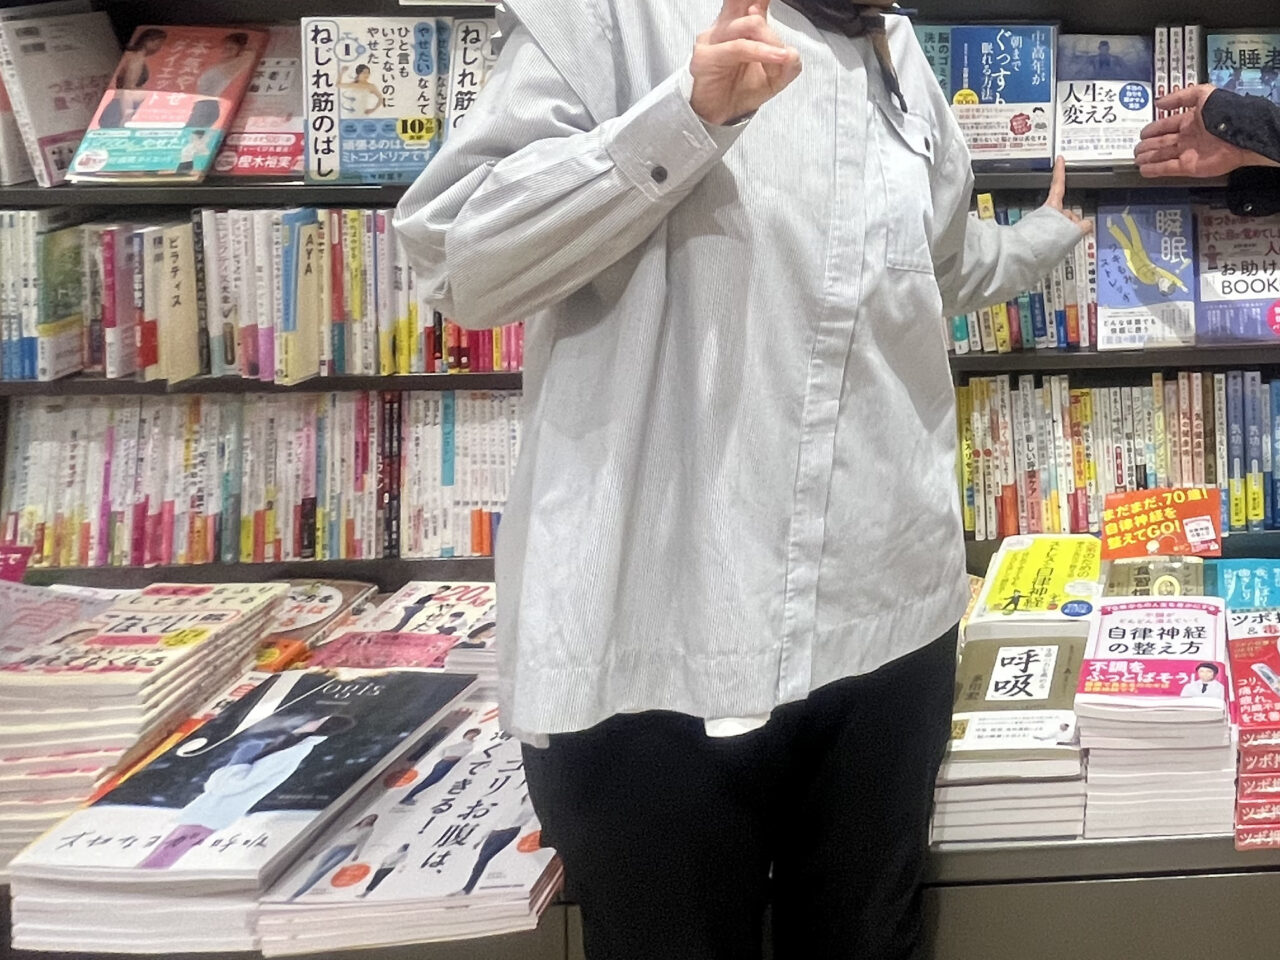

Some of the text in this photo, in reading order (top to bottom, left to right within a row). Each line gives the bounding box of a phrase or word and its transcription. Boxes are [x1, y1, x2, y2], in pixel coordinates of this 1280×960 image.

[367, 27, 380, 65] やせた
[397, 27, 410, 78] ひと言も
[382, 27, 395, 108] いってないのに
[417, 27, 430, 115] やせたい なんて
[311, 25, 335, 178] ねじれ筋のばし
[1064, 83, 1117, 103] 人生を
[1063, 105, 1117, 125] 変える
[1156, 209, 1188, 263] 瞬眠
[304, 233, 314, 277] AYA
[1221, 259, 1278, 277] お助け
[168, 238, 182, 309] ピラティス
[1221, 277, 1280, 295] BOOK
[1104, 488, 1208, 521] まだまだ、70歳!
[1104, 507, 1178, 535] 自律神経を
[1107, 521, 1182, 550] 整えてGO!
[1107, 626, 1208, 641] 自律神経
[1108, 641, 1204, 656] の整え方
[994, 649, 1041, 697] 呼吸
[1090, 661, 1145, 674] 不調を
